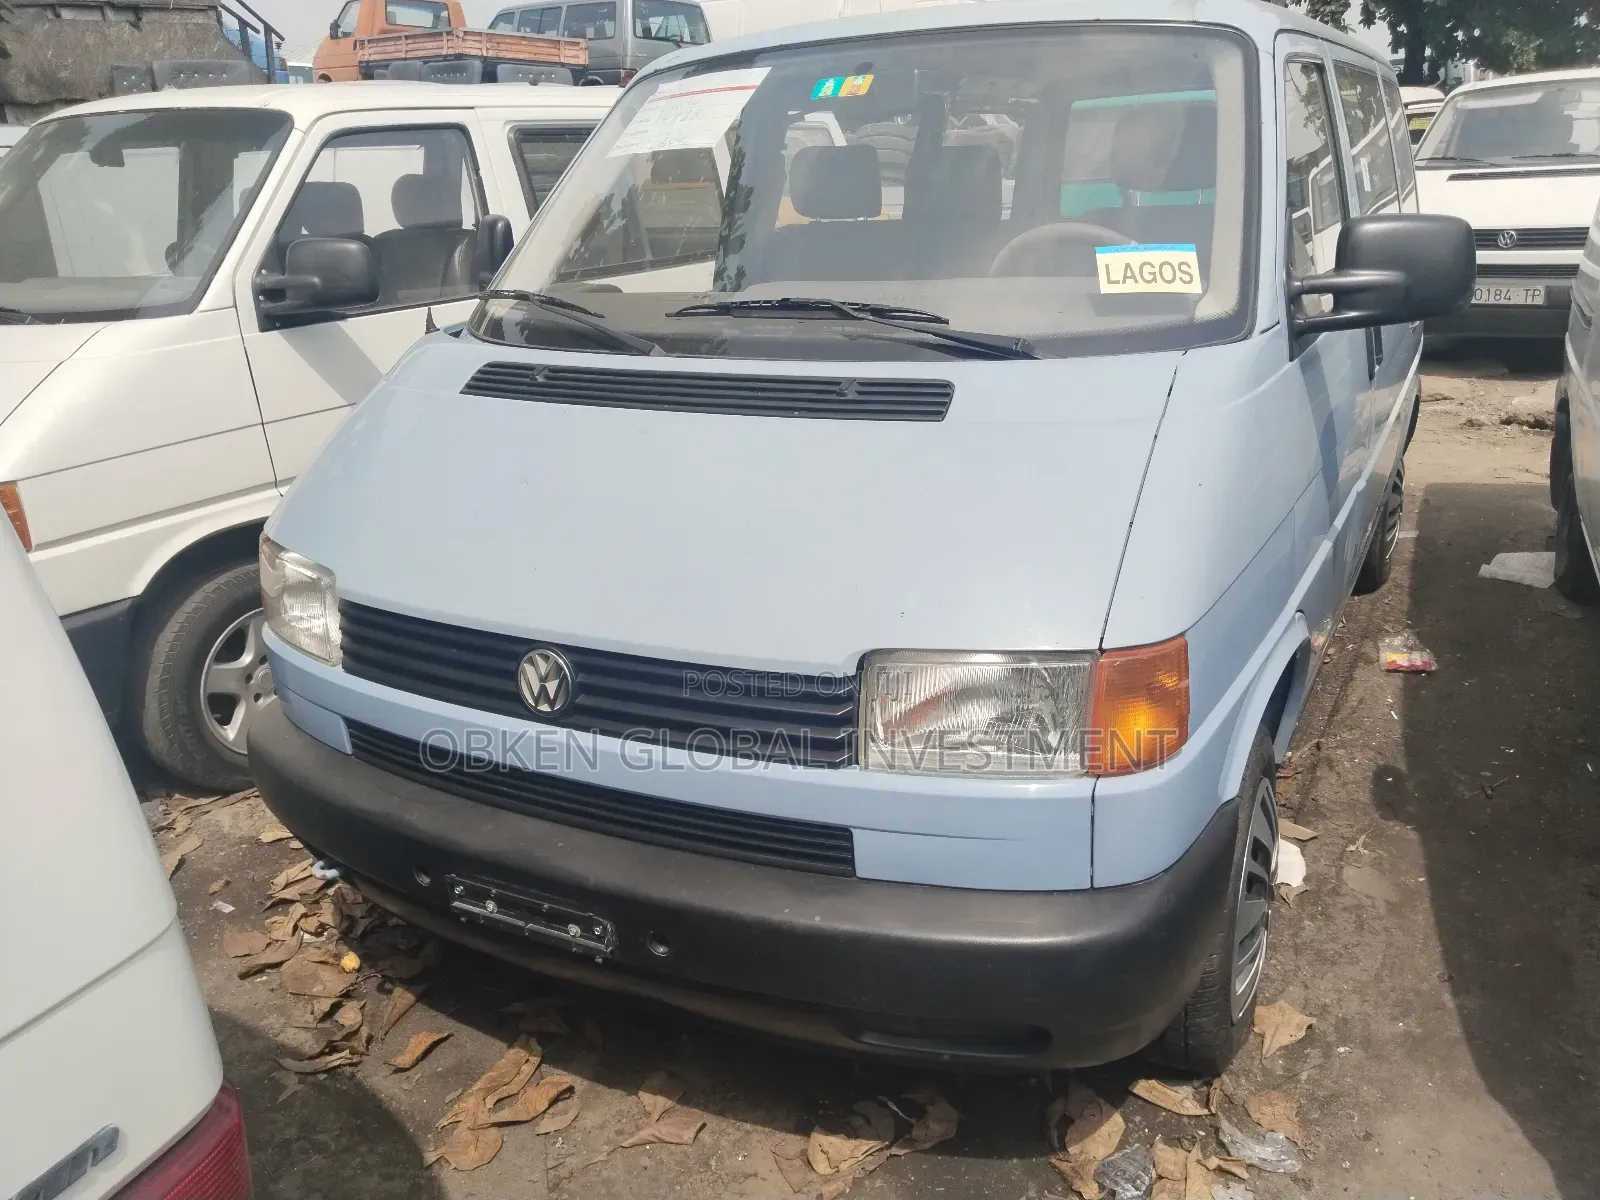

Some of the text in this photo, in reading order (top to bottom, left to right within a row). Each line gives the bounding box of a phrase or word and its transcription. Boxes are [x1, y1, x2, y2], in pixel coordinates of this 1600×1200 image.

[1498, 230, 1517, 248] VW
[1105, 261, 1194, 285] LAGOS
[1523, 288, 1542, 303] TP
[518, 648, 572, 717] VW
